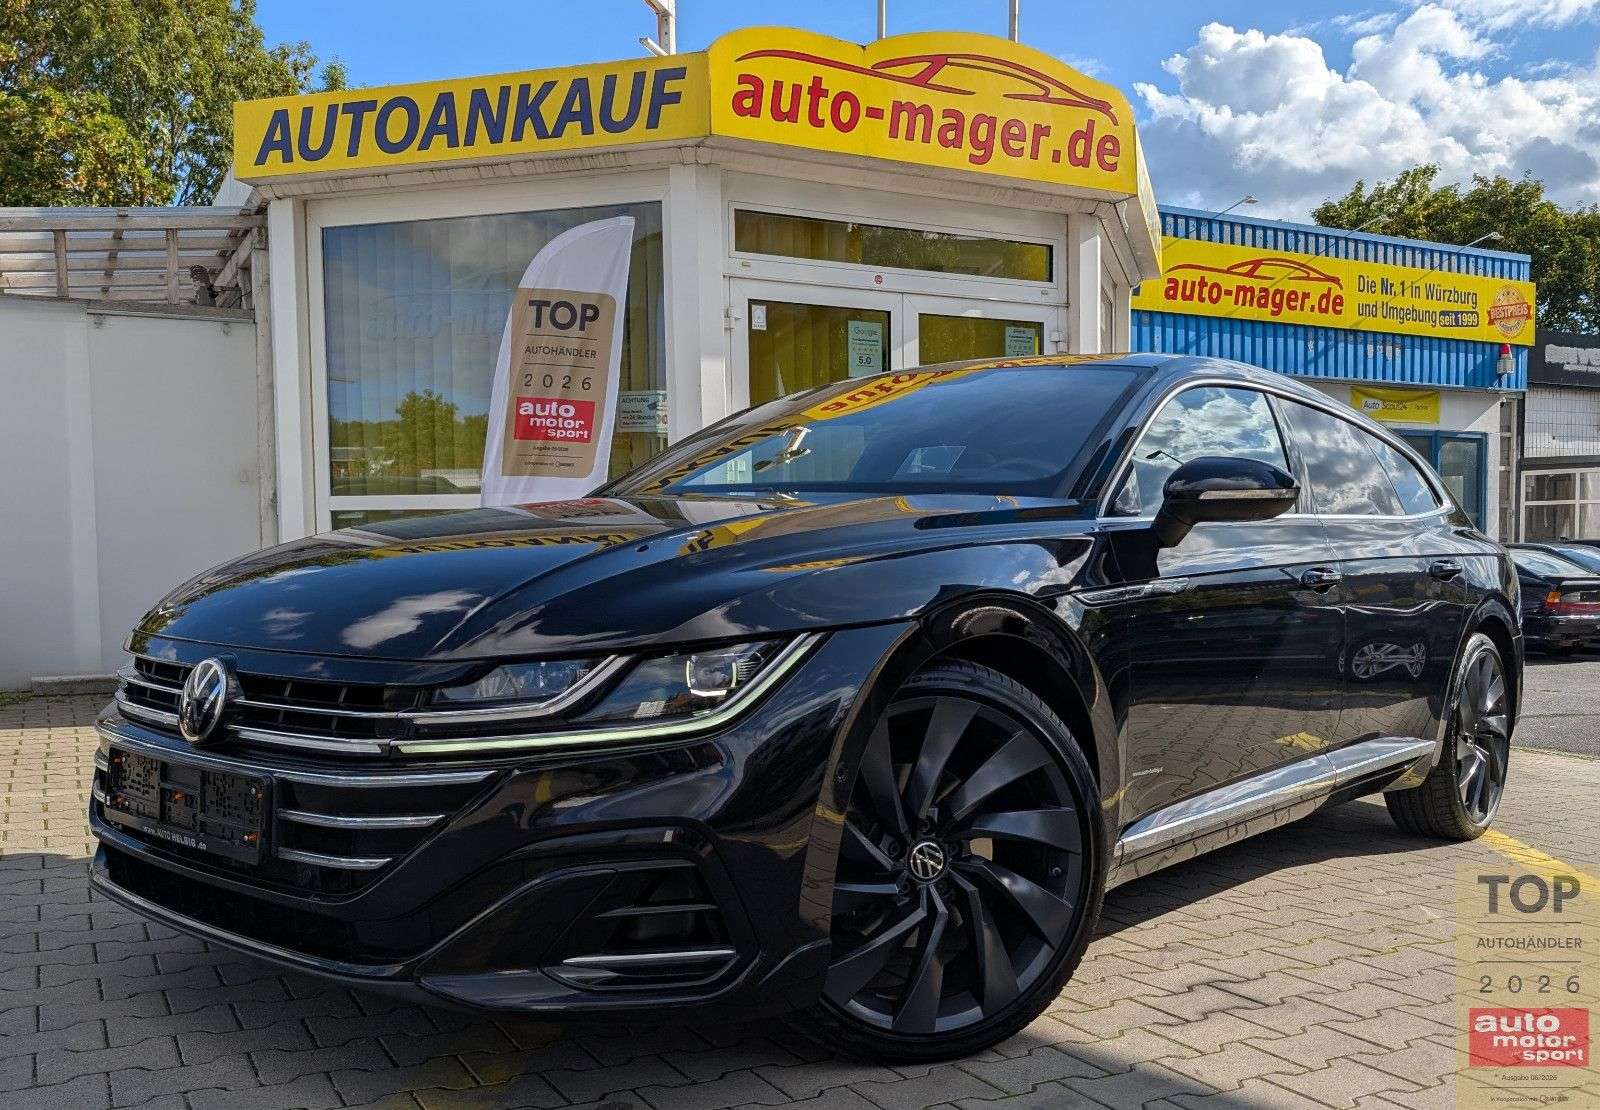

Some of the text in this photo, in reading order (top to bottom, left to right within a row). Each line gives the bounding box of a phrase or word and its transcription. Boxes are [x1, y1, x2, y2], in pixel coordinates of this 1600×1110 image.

[254, 67, 687, 166] AUTOANKAUF
[732, 74, 1121, 172] auto-mager.de
[1164, 276, 1344, 316] auto-mager.de
[1358, 275, 1478, 309] Die Nr. 1 in Würzburg
[529, 300, 600, 332] TOP
[1358, 300, 1478, 328] und Umgebung seit 1999
[524, 344, 597, 360] AUTOHÄNDLER
[858, 355, 872, 365] 5.0
[519, 401, 576, 418] auto
[529, 416, 585, 429] motor
[547, 428, 588, 440] sport
